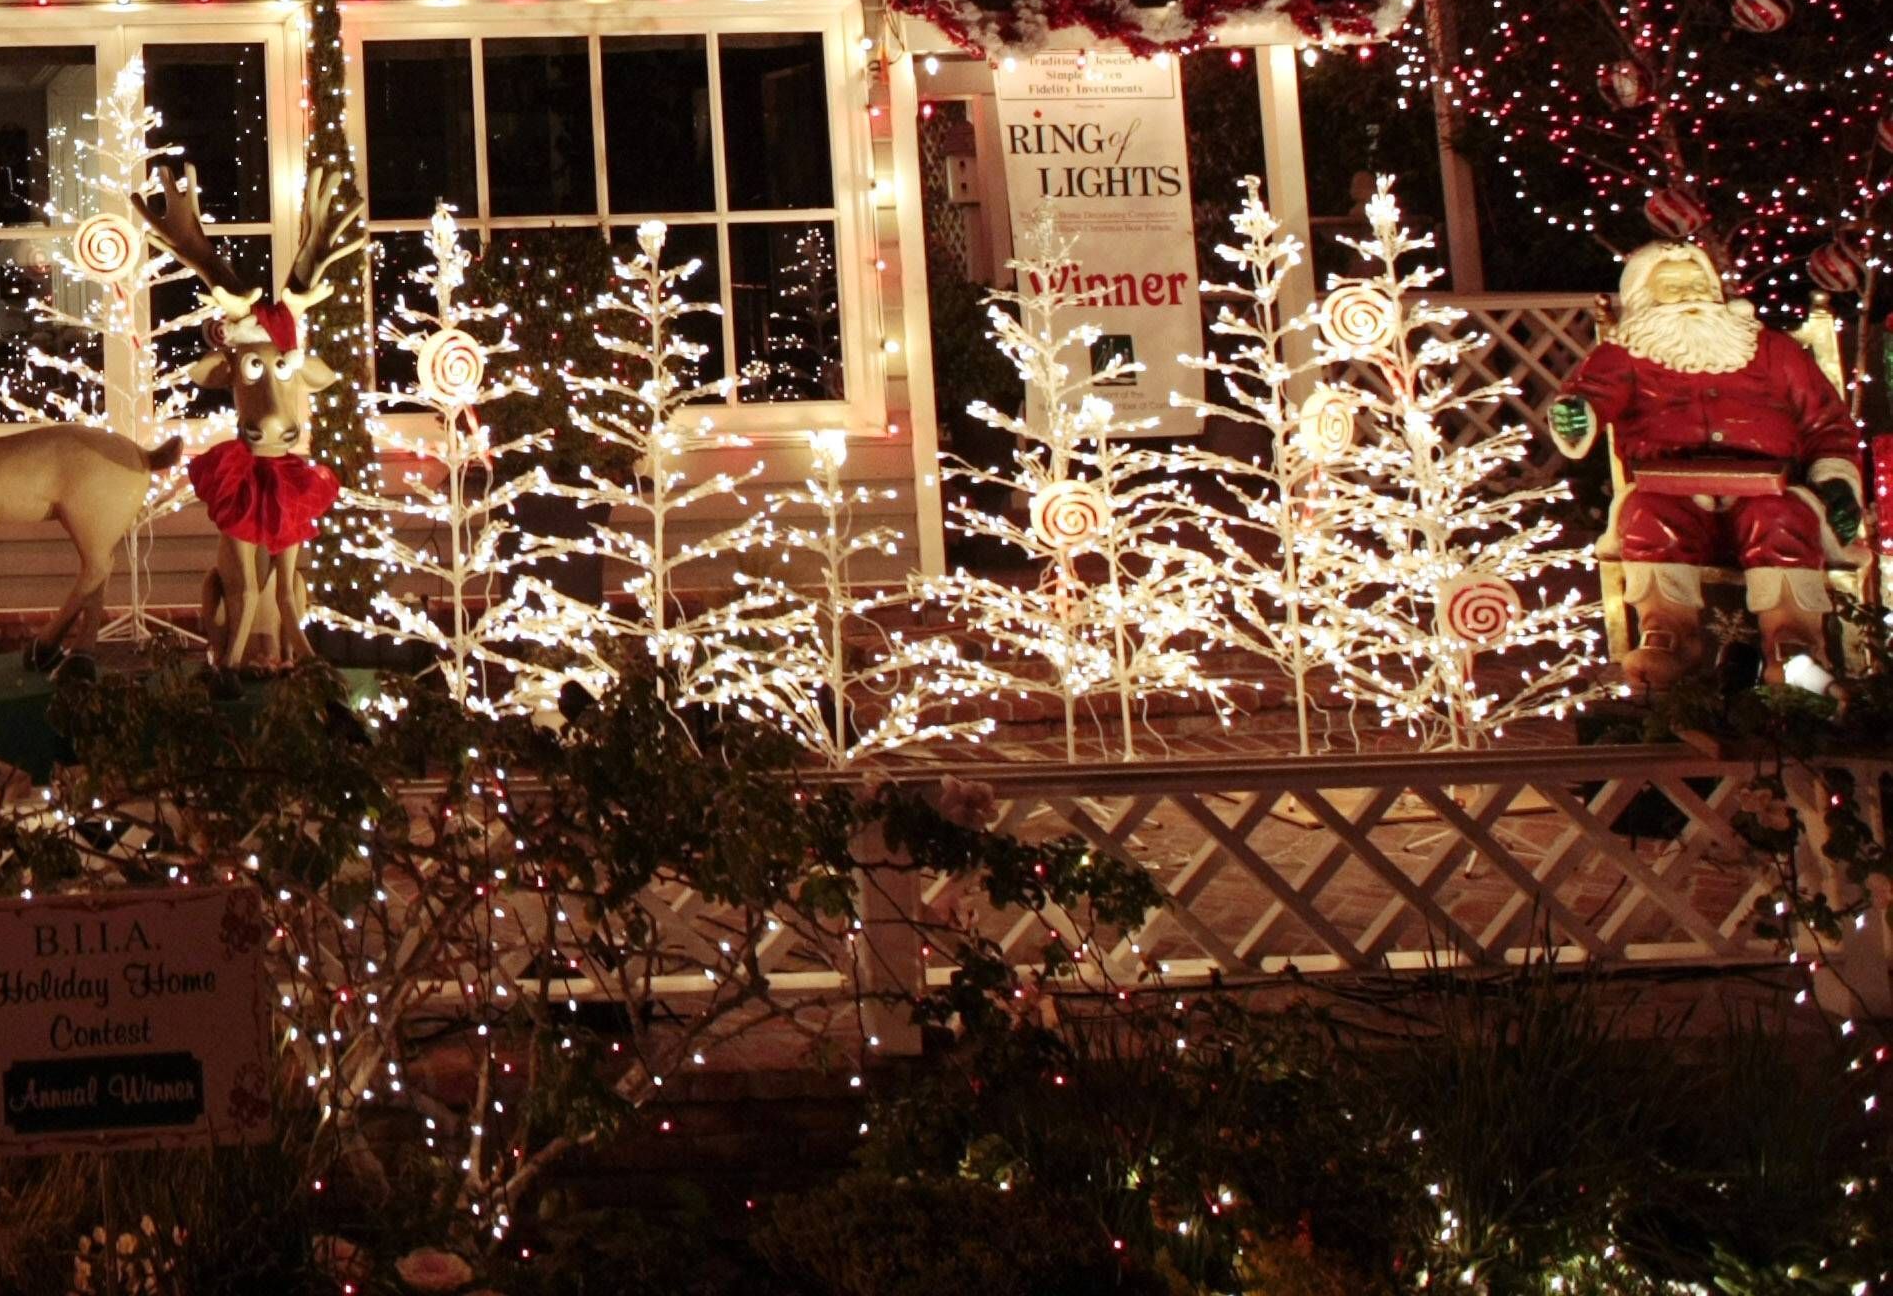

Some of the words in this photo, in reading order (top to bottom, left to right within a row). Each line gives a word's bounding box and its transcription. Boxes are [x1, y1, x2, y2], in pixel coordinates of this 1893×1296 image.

[1029, 55, 1089, 66] Traditionl
[1045, 70, 1084, 83] Simple
[1028, 84, 1071, 97] Fidelity
[1076, 83, 1143, 96] Investments
[1006, 123, 1105, 155] RING
[1108, 117, 1142, 164] of
[1037, 165, 1182, 198] LIGHTS
[1028, 262, 1189, 307] Winner
[34, 920, 162, 957] B.I.I.A.
[123, 961, 217, 999] Home
[49, 1013, 152, 1052] Contest
[9, 1076, 99, 1112] Annual
[107, 1072, 196, 1106] Winner
